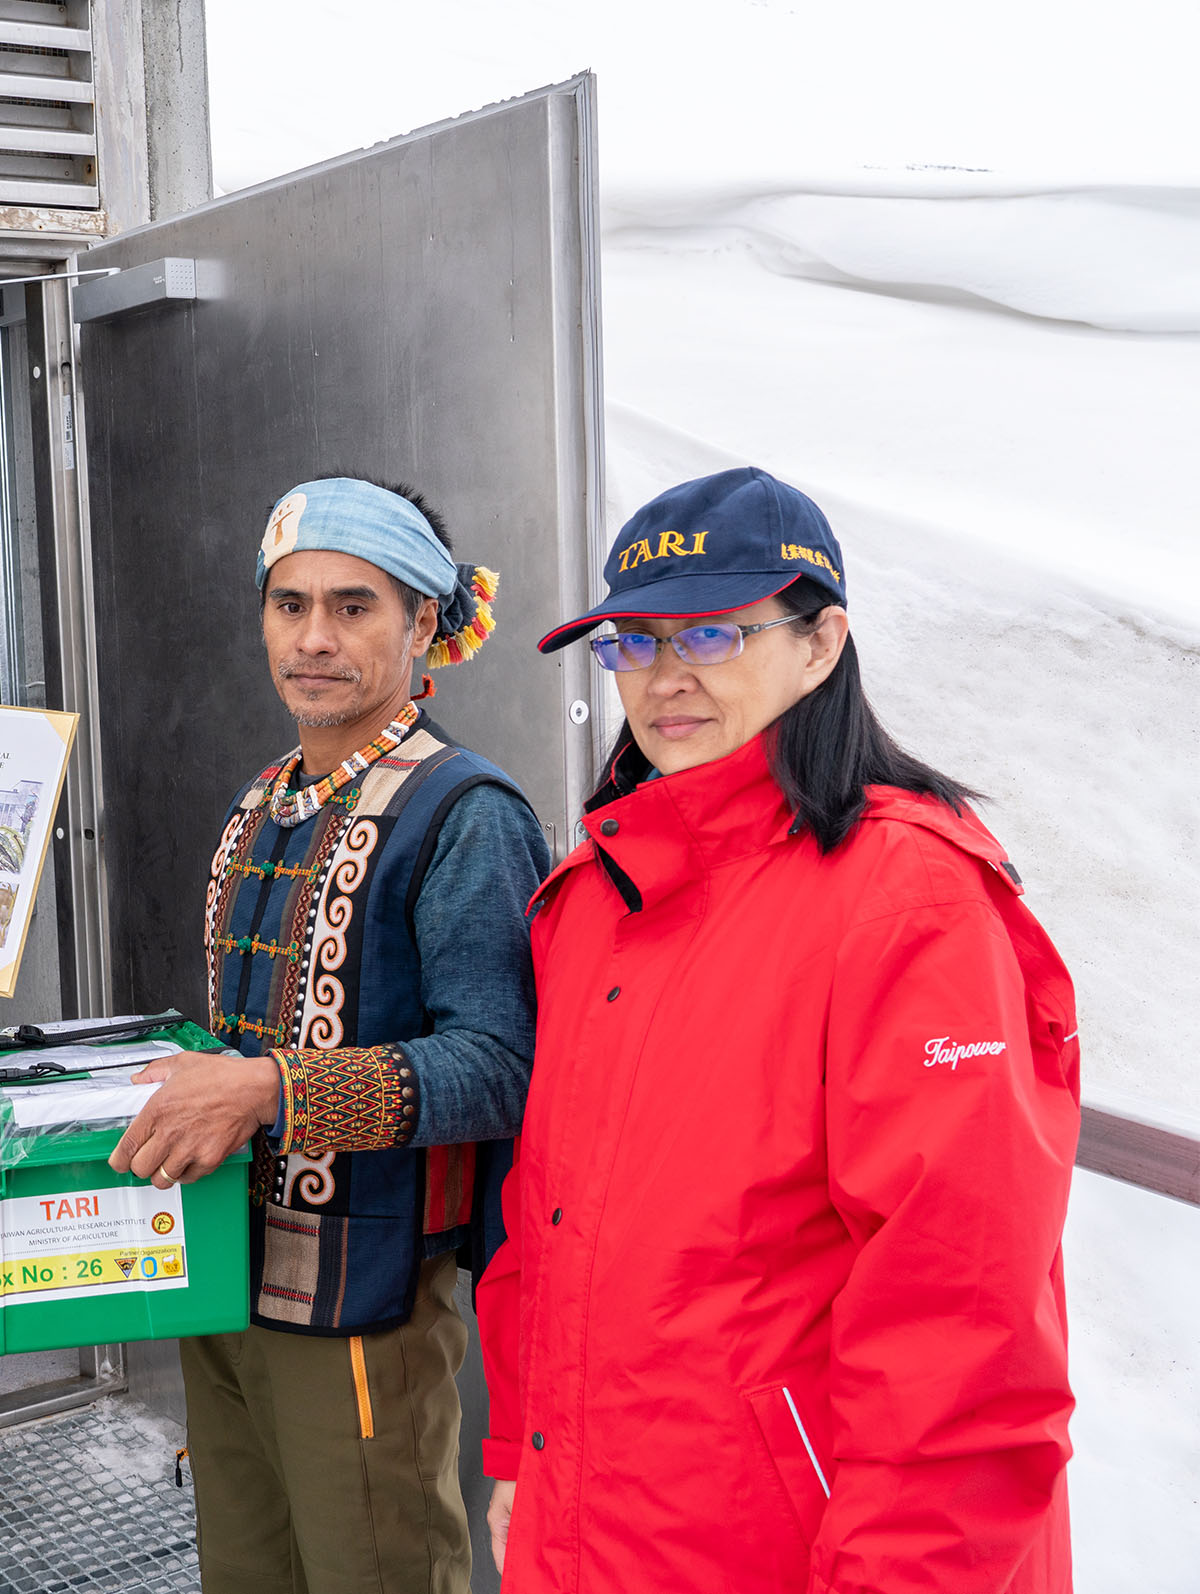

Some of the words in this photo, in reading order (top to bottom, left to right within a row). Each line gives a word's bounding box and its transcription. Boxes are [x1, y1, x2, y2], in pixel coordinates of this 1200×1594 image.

[618, 530, 709, 573] TARI
[923, 1036, 1007, 1070] Taipower
[39, 1195, 99, 1221] TARI
[26, 1225, 76, 1236] AGRICULTURAL
[78, 1220, 112, 1230] RESEARCH
[114, 1218, 146, 1227] INSTITUTE
[28, 1236, 60, 1246] MINISTRY
[62, 1235, 70, 1243] OF
[72, 1230, 119, 1241] AGRICULTURE
[140, 1247, 177, 1256] Organizations
[22, 1265, 53, 1284] No
[76, 1258, 103, 1278] 26
